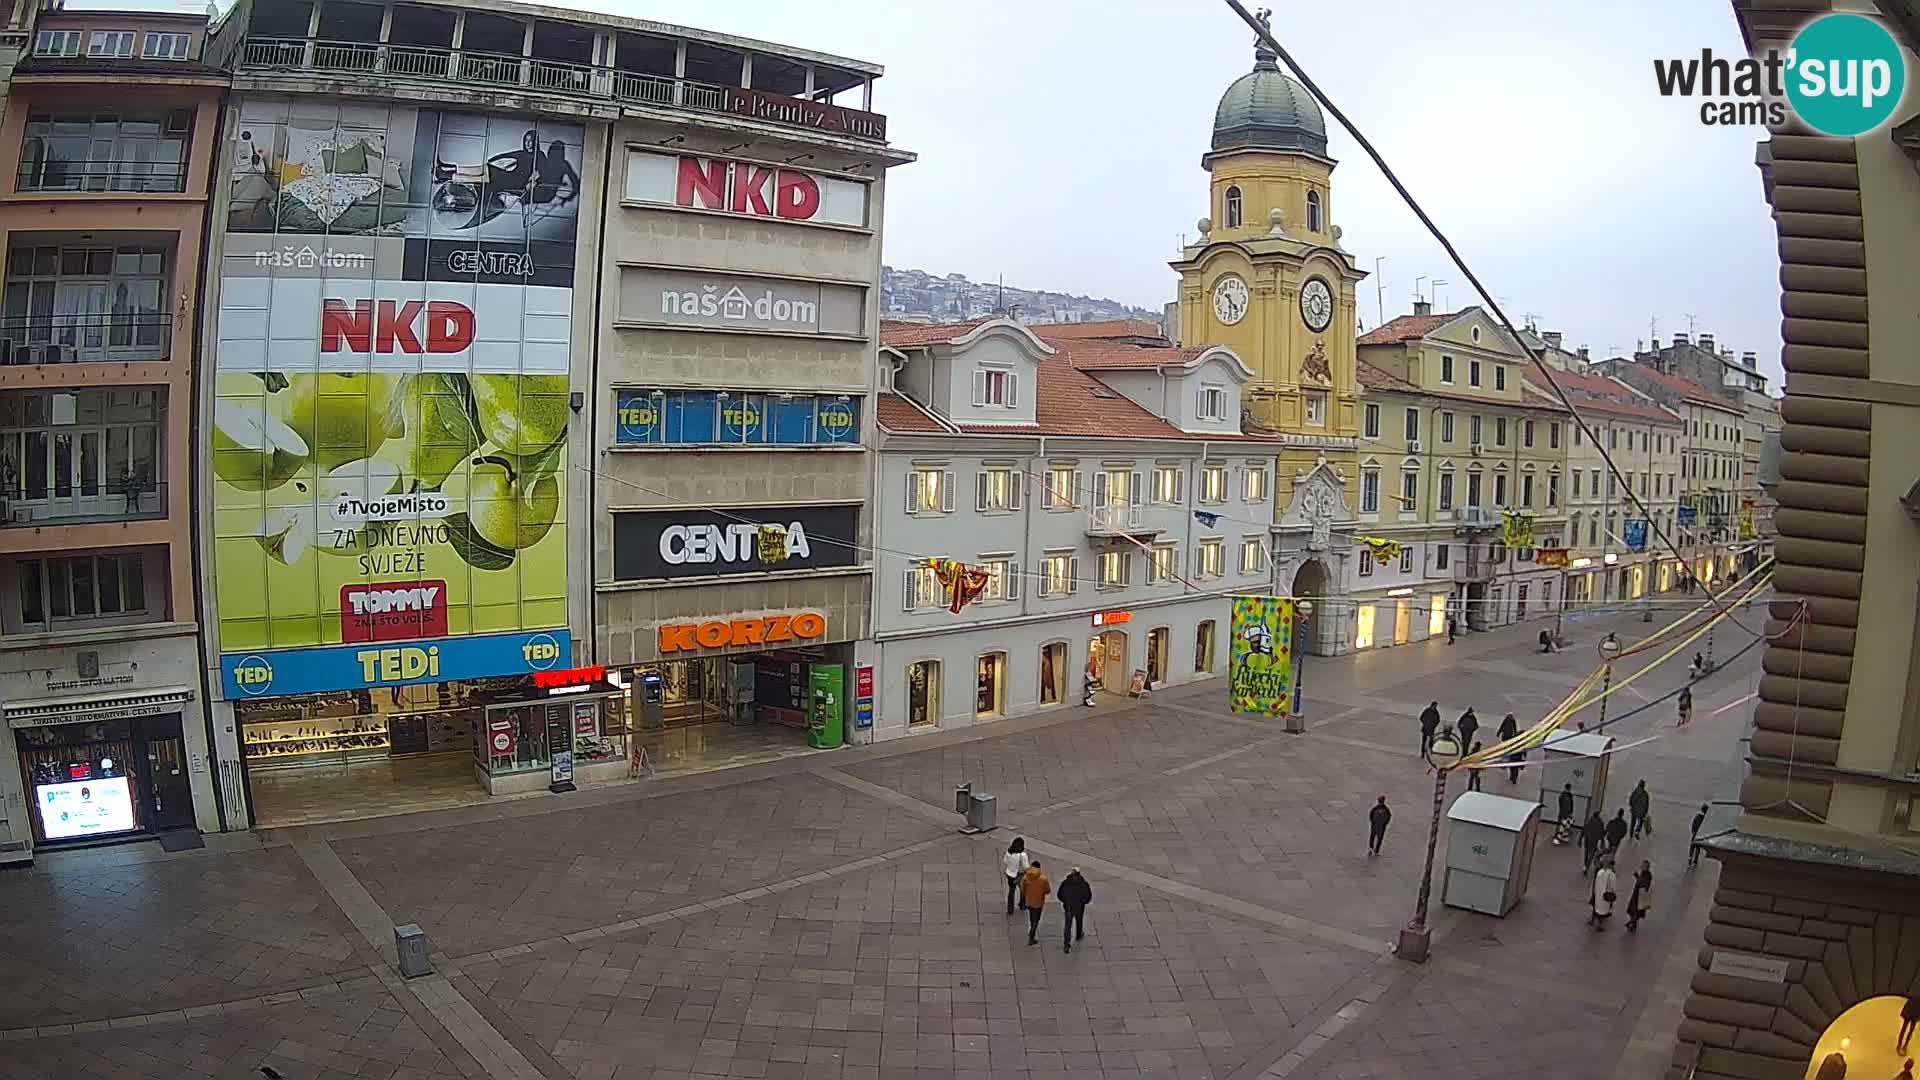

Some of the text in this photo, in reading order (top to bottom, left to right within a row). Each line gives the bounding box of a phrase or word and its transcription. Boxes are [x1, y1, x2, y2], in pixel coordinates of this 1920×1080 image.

[723, 89, 746, 112] Le
[675, 158, 821, 221] NKD
[255, 246, 366, 269] naš dom
[447, 250, 535, 277] CENTRA
[661, 284, 817, 323] naš dom
[319, 297, 477, 355] NKD
[618, 408, 658, 426] TEDi
[723, 409, 760, 427] TEDi
[819, 410, 853, 427] TEDi
[337, 497, 446, 517] #TvojeMisto
[332, 523, 451, 550] ZA DNEVNO
[659, 521, 811, 564] CENTA
[359, 548, 427, 576] SVJEŽE
[348, 587, 440, 615] TOMMY
[658, 612, 827, 654] KORZO
[357, 645, 440, 683] TEDi
[521, 643, 560, 661] TEDi
[233, 666, 273, 685] TEDi
[132, 706, 162, 717] CENTAR
